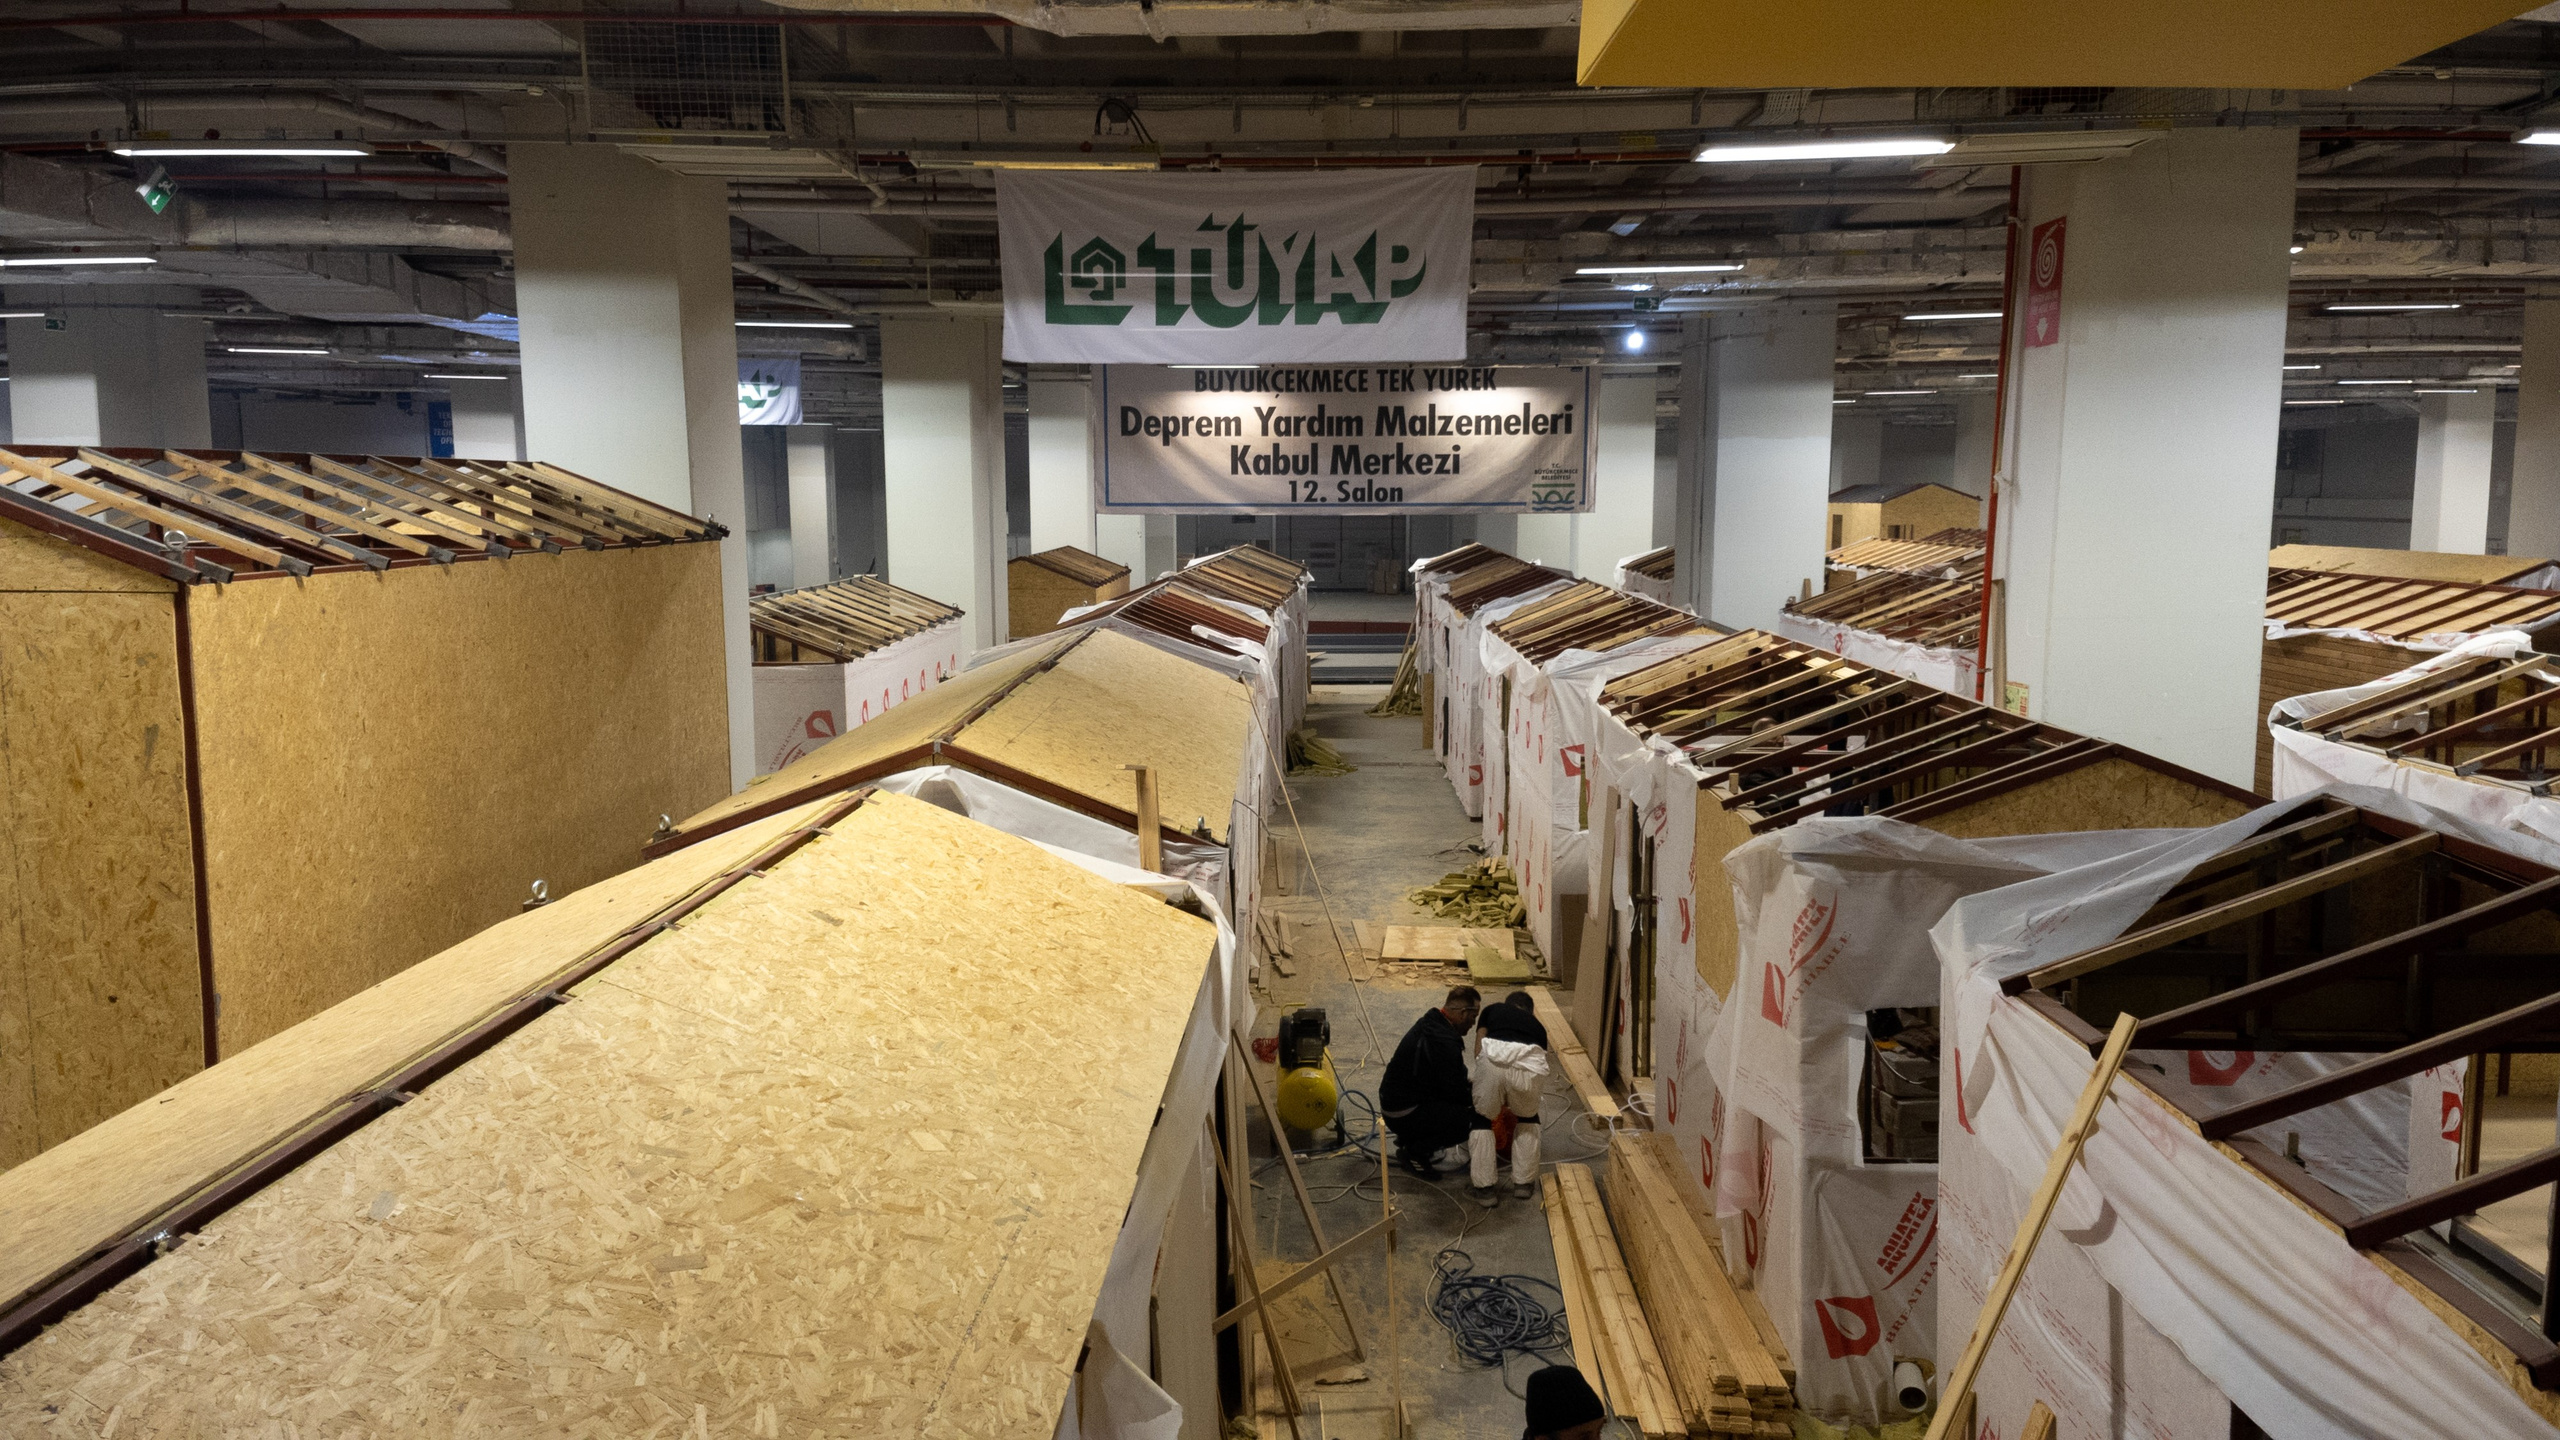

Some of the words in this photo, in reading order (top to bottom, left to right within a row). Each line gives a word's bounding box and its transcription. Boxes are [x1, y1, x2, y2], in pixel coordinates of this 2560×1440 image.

[1137, 212, 1426, 328] TÜYAP
[1377, 369, 1415, 392] TEK
[1120, 405, 1242, 446] Deprem
[1254, 404, 1363, 437] Yardım
[1375, 402, 1573, 436] Malzemeleri
[1231, 443, 1319, 475] Kabul
[1330, 442, 1461, 475] Merkezi
[1289, 480, 1328, 502] 12.
[1337, 479, 1403, 503] Salon
[1876, 1190, 1935, 1276] AQUATEX
[1885, 1252, 1938, 1344] BREATHA
